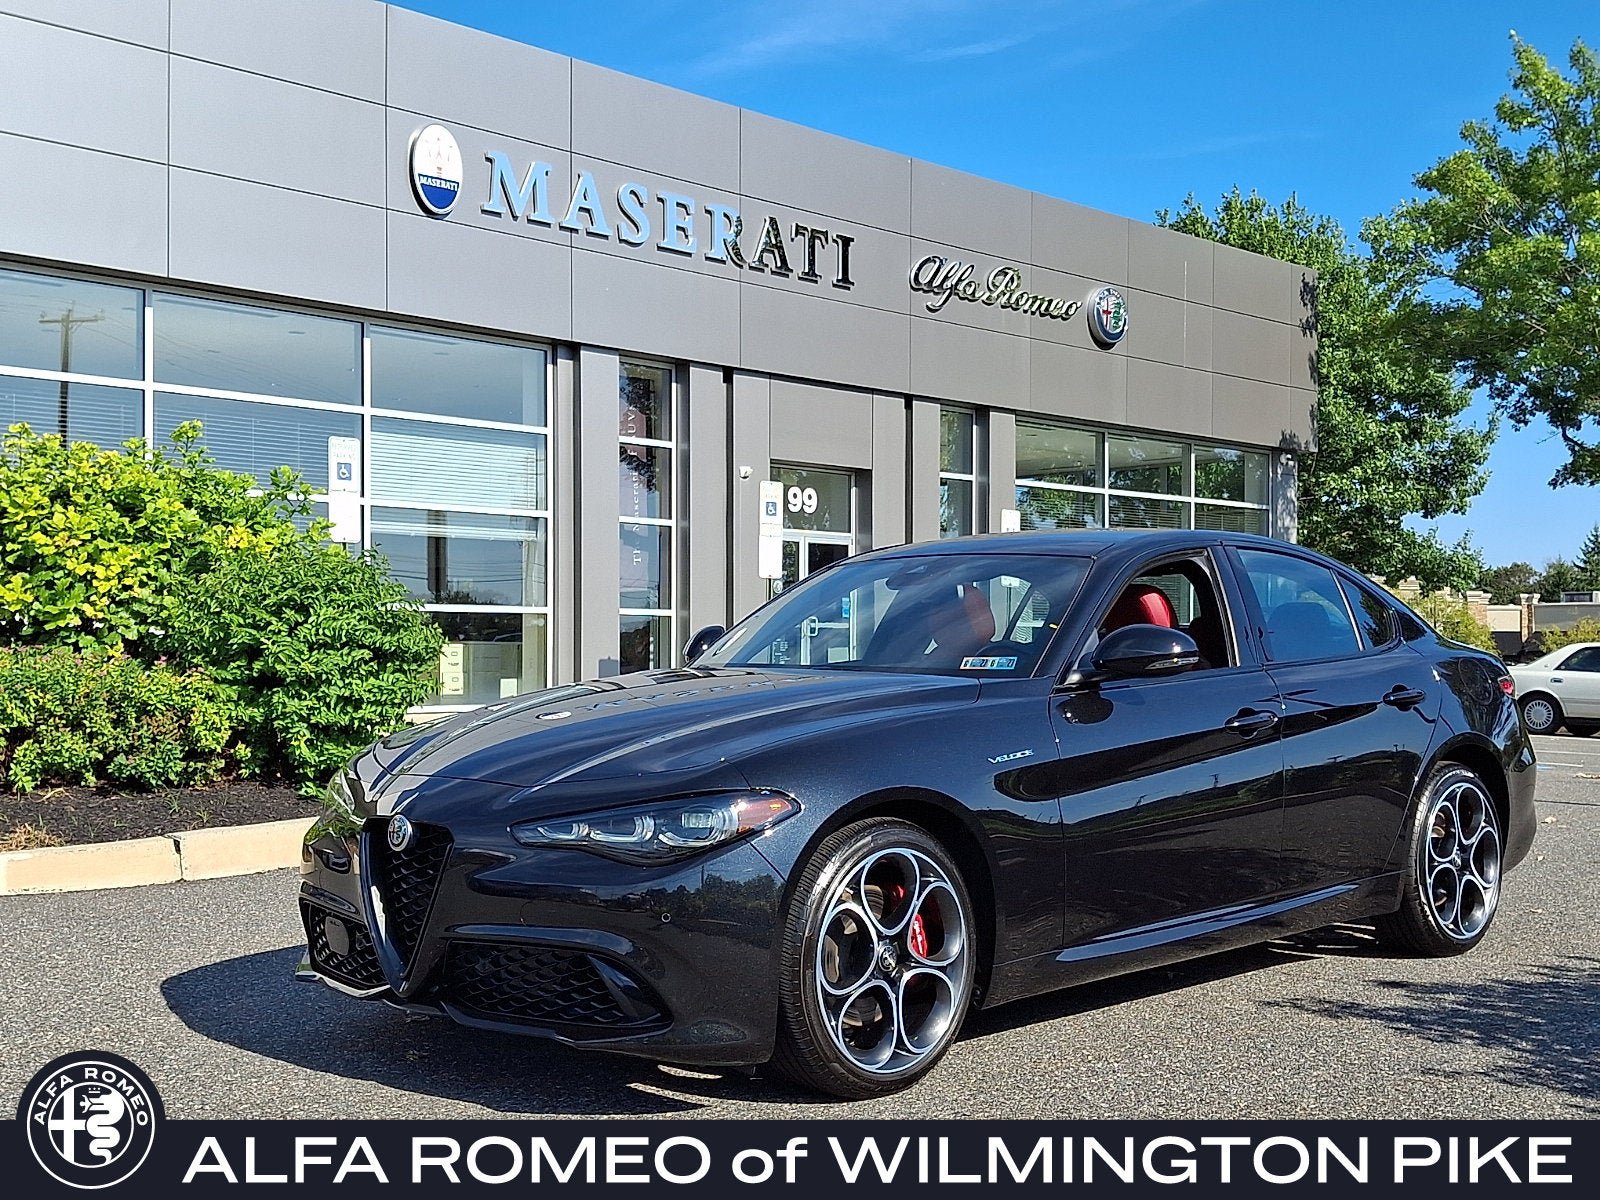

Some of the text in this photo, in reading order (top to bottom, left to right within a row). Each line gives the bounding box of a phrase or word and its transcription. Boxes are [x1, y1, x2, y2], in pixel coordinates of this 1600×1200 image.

[419, 175, 459, 192] MASERATI
[483, 150, 855, 290] MASERATI
[909, 255, 983, 313] Alfa
[986, 266, 1082, 321] Romeo
[787, 486, 818, 514] 99
[987, 749, 1034, 764] VELOCE
